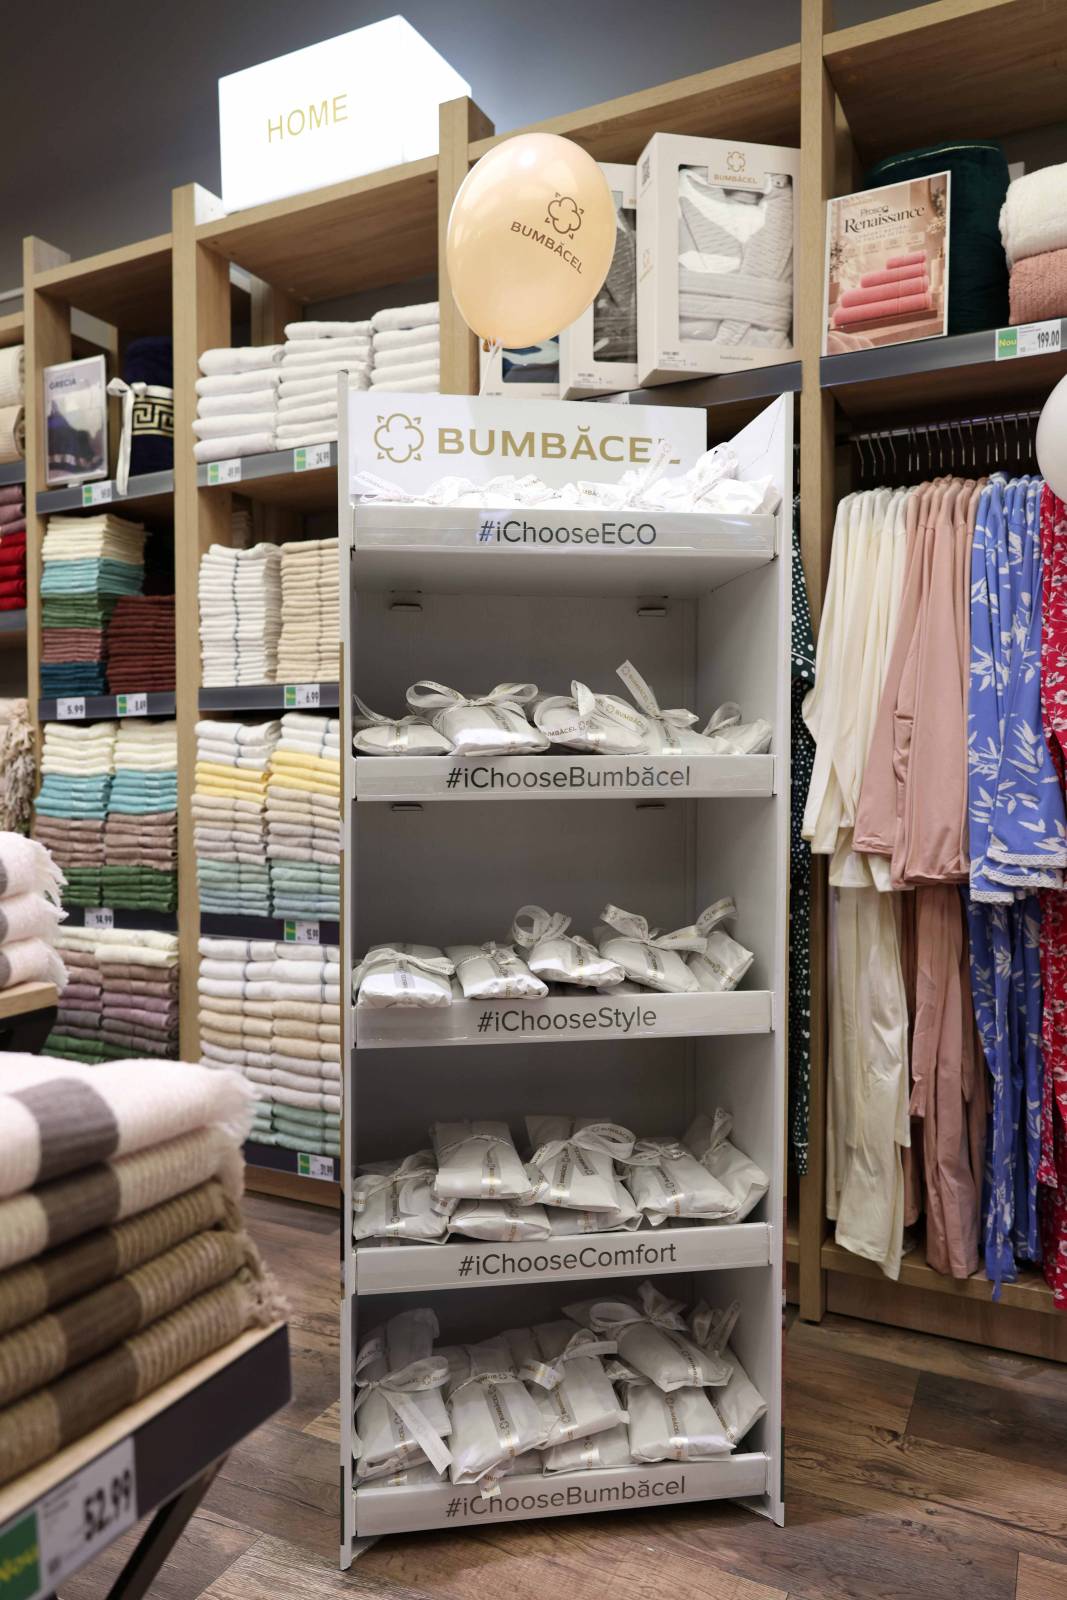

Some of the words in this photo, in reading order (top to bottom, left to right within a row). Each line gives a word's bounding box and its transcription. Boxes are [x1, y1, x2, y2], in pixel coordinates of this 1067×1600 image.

[268, 93, 348, 144] HOME
[844, 206, 925, 234] Renaissance
[510, 221, 583, 274] BUMBĂCEL
[1037, 329, 1060, 349] 199.00
[479, 520, 657, 546] #iChooseECO
[446, 766, 691, 789] #iChooseBumbăcel
[477, 1005, 658, 1033] #iChooseStyle
[458, 1243, 677, 1278] #iChooseComfort
[446, 1475, 686, 1518] #iChooseBumbăcel
